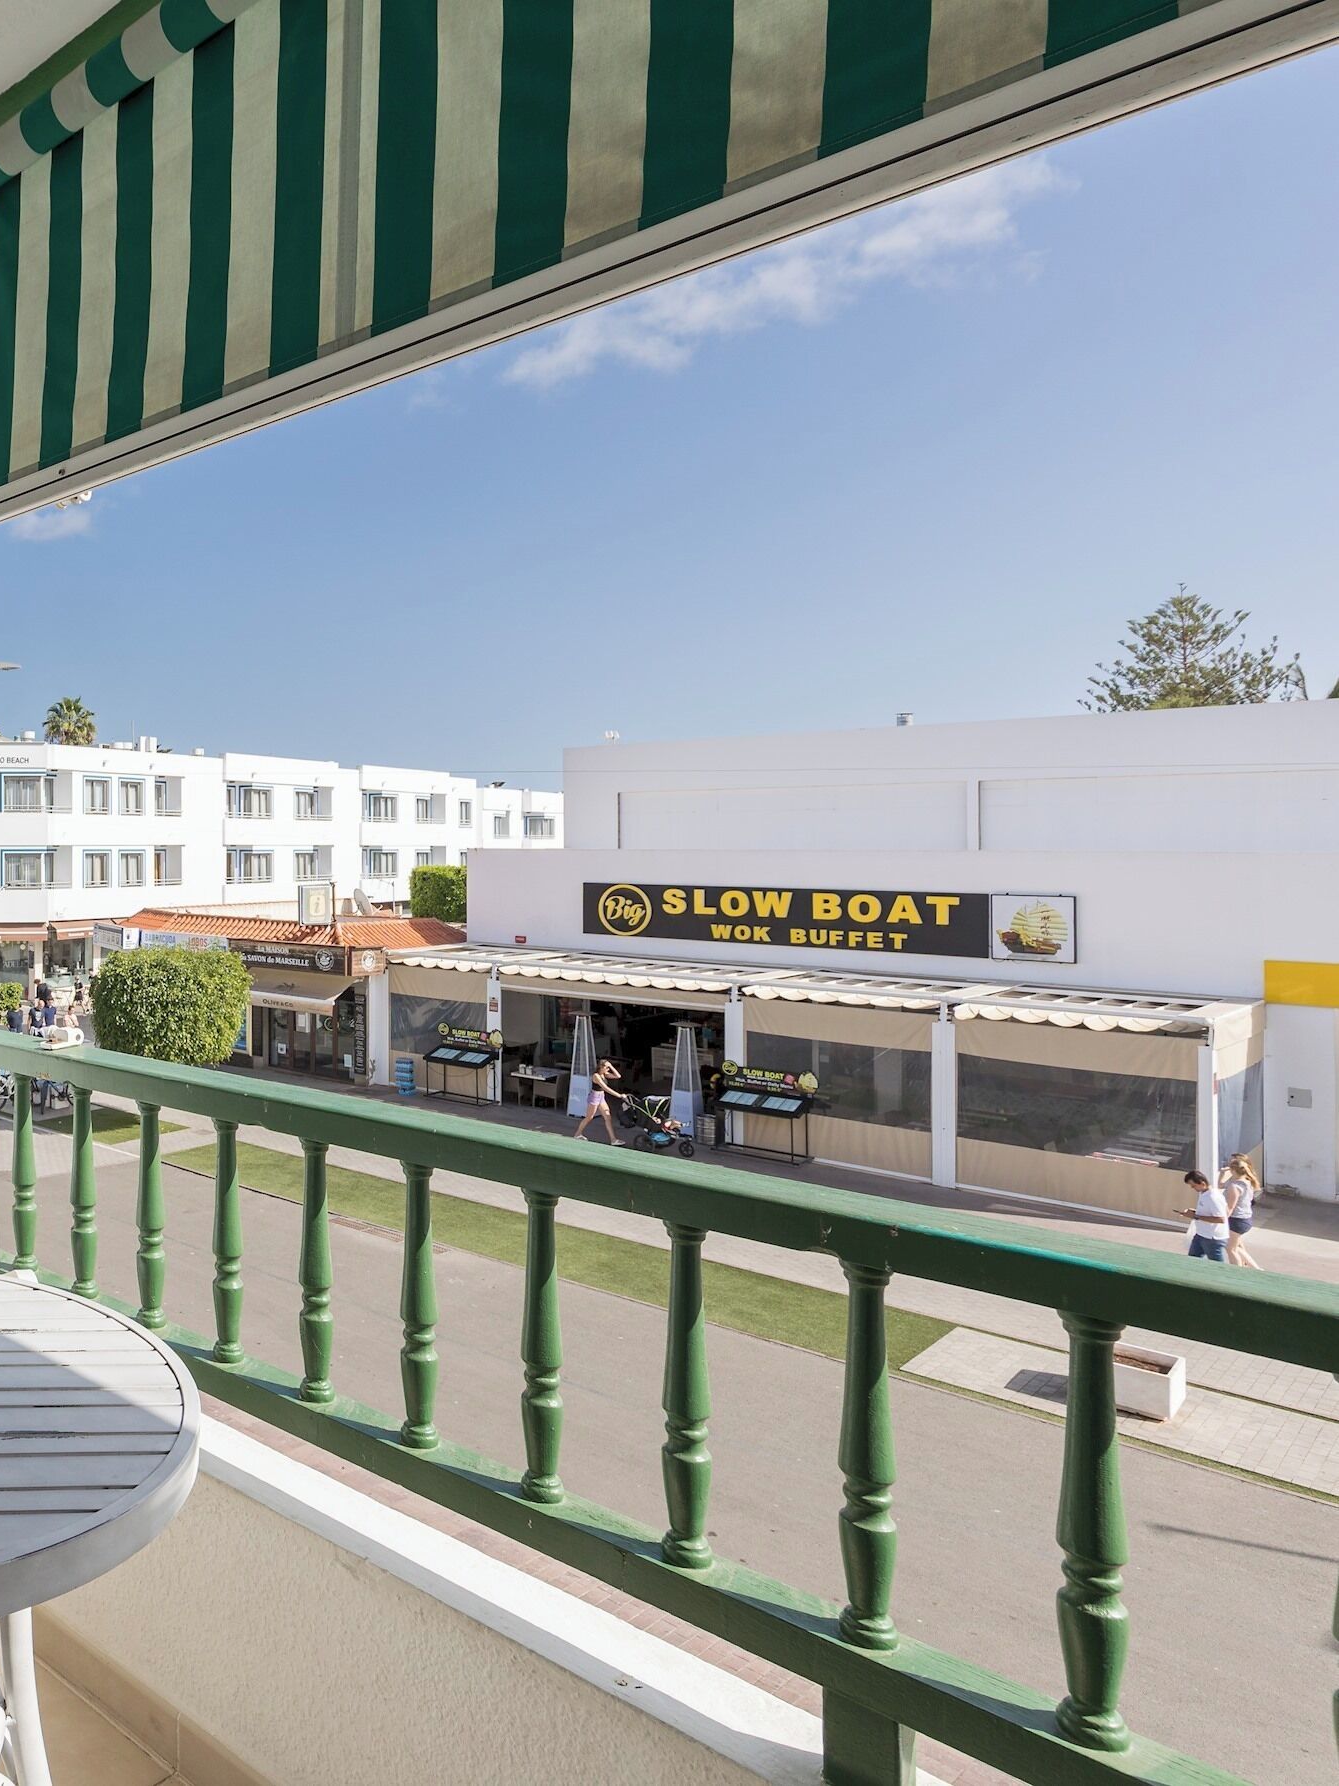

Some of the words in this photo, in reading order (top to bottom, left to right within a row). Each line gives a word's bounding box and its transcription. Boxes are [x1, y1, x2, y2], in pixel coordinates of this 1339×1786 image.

[605, 895, 646, 926] Big
[661, 888, 793, 918] SLOW
[811, 892, 960, 926] BOAT
[710, 924, 772, 942] WOK
[789, 928, 908, 950] BUFFET
[265, 946, 289, 955] MAISON
[247, 955, 266, 963] SAVON
[266, 956, 274, 964] de
[275, 957, 310, 967] MARSEILLE
[743, 1068, 763, 1077] SLOW
[764, 1071, 785, 1080] BOAT
